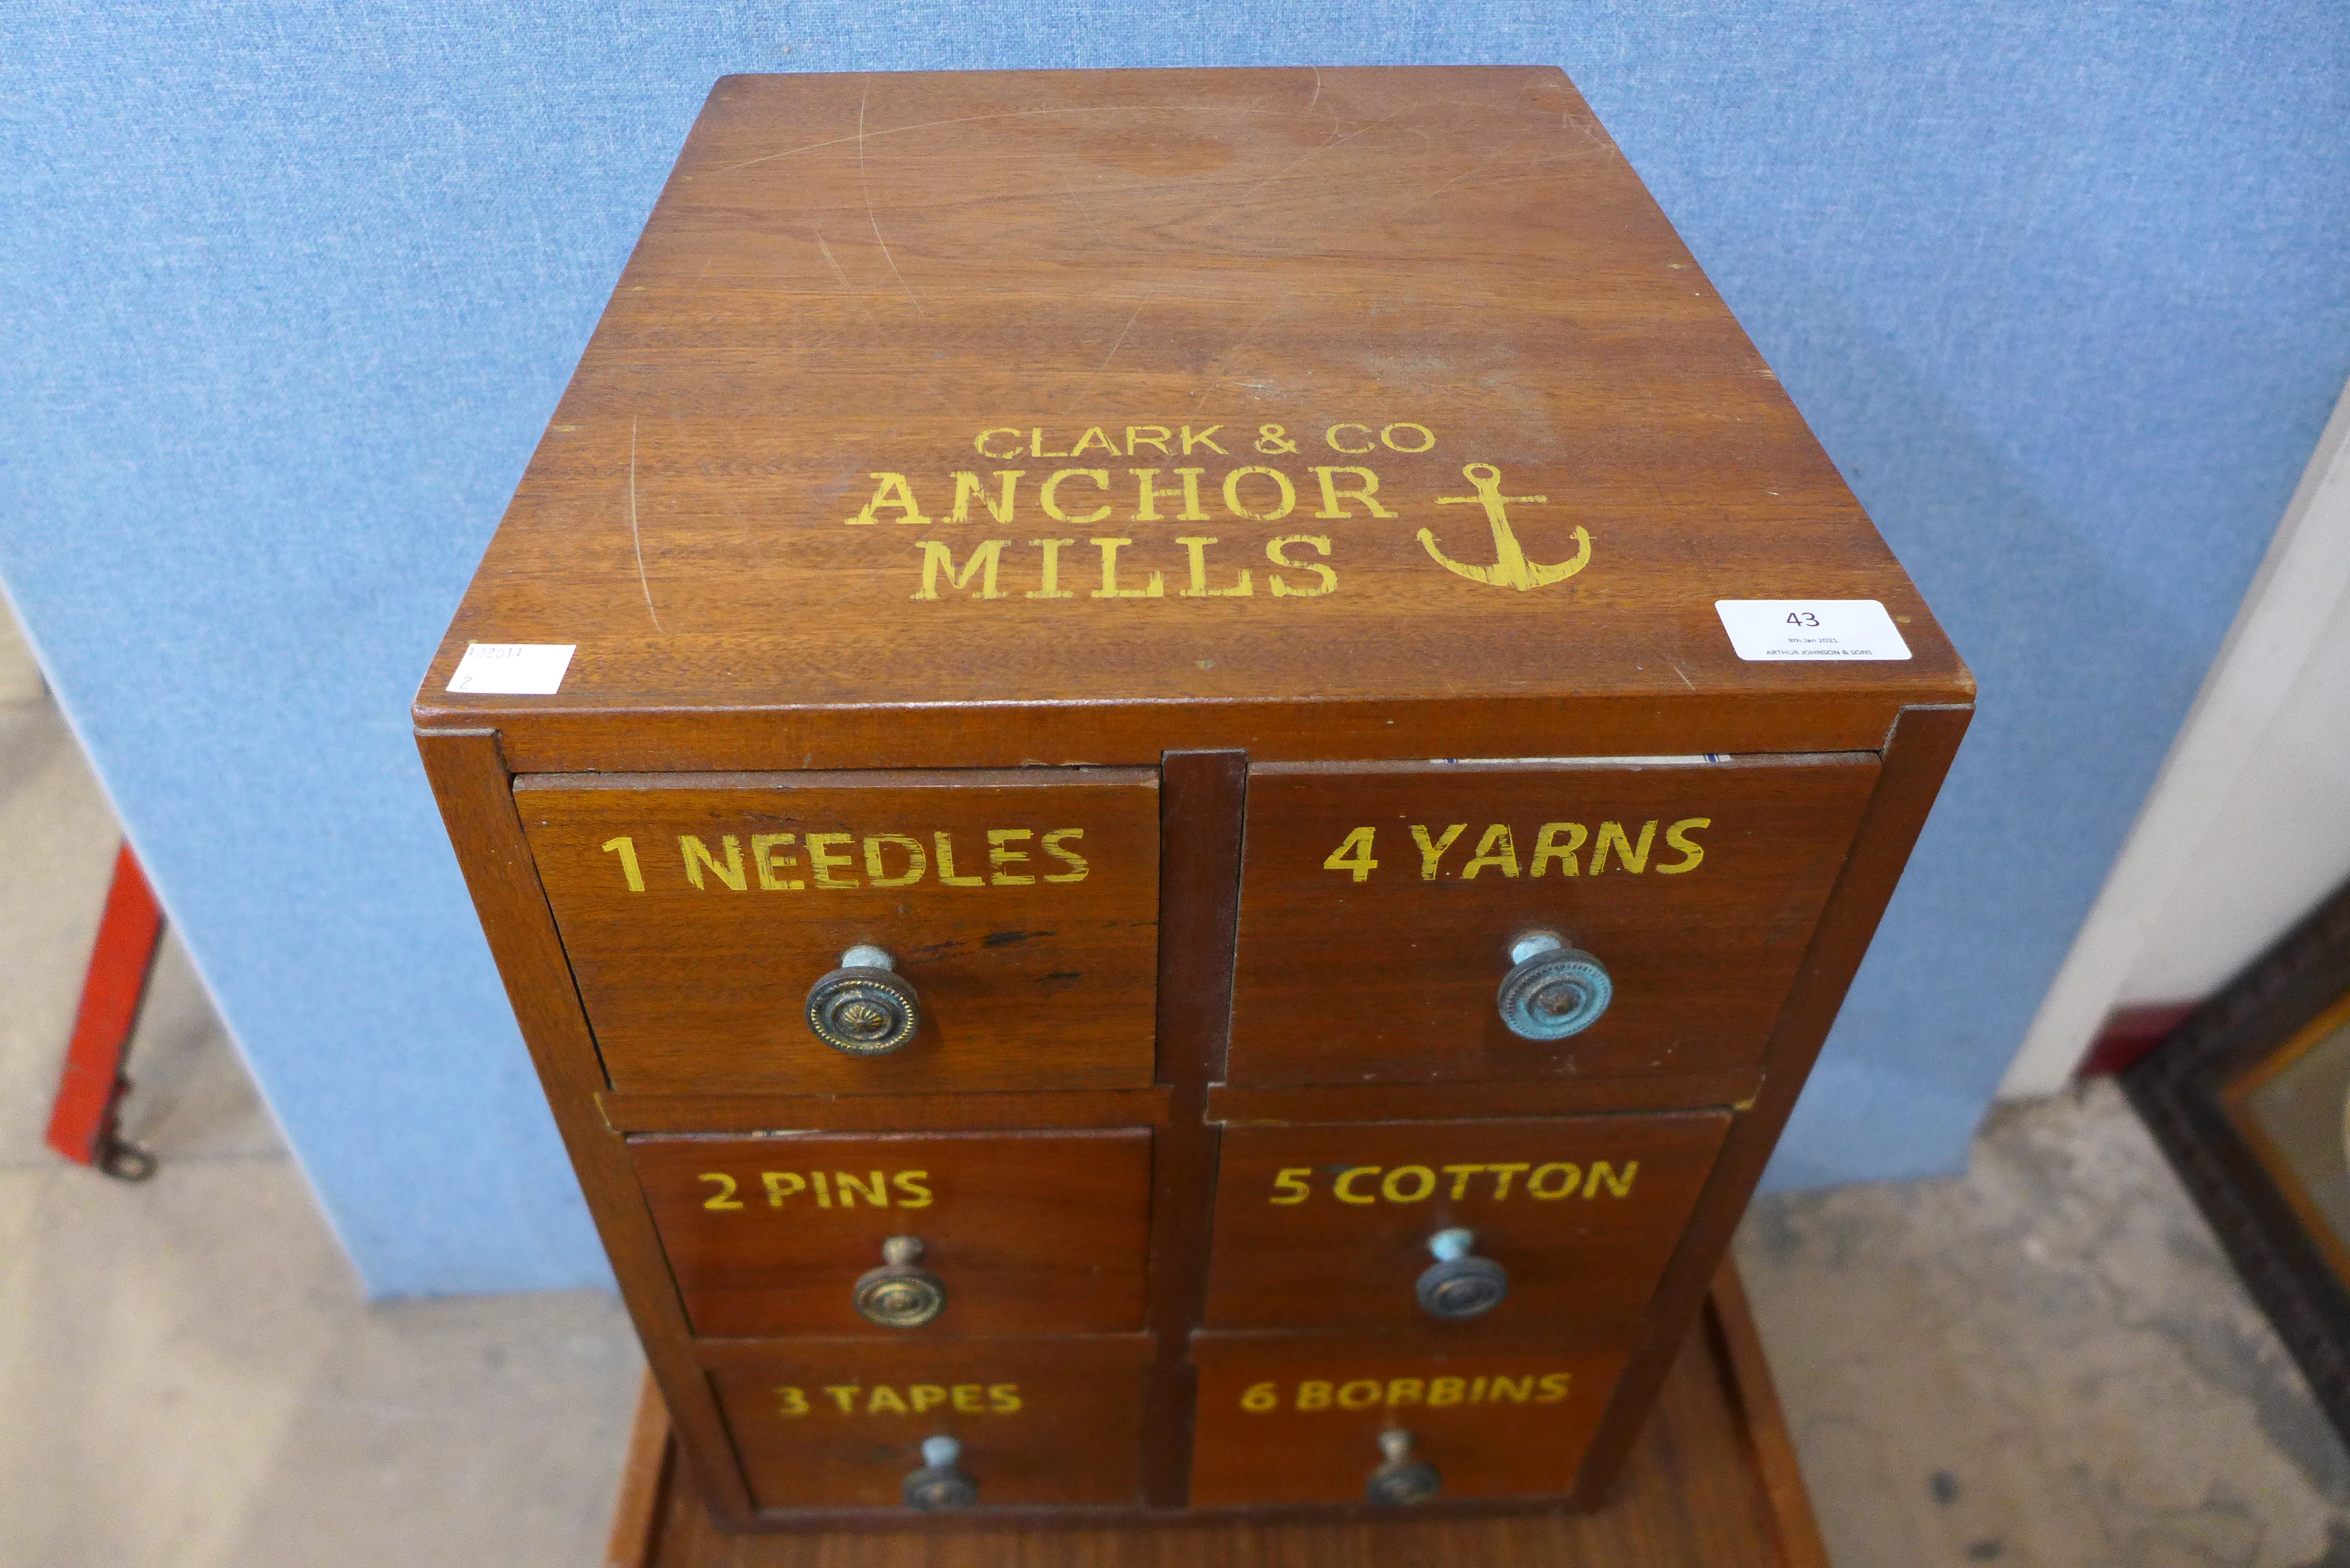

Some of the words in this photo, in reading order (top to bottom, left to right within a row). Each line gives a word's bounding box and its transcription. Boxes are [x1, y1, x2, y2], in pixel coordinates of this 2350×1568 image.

[973, 424, 1229, 459] CLARK
[1253, 423, 1297, 455] &
[1325, 422, 1438, 454] CO
[845, 465, 1399, 526] ANCHOR
[909, 534, 1338, 600] MILLS
[1786, 612, 1820, 627] 43
[600, 836, 646, 894] 1
[677, 827, 1090, 892] NEEDLES
[1323, 826, 1379, 883] 4
[1409, 817, 1712, 881] YARNS
[698, 1173, 744, 1211] 2
[761, 1169, 933, 1209] PINS
[1270, 1167, 1313, 1206] 5
[1332, 1161, 1639, 1205] COTTON
[776, 1385, 812, 1416] 3
[825, 1382, 1024, 1414] TAPES
[1240, 1381, 1278, 1412] 6
